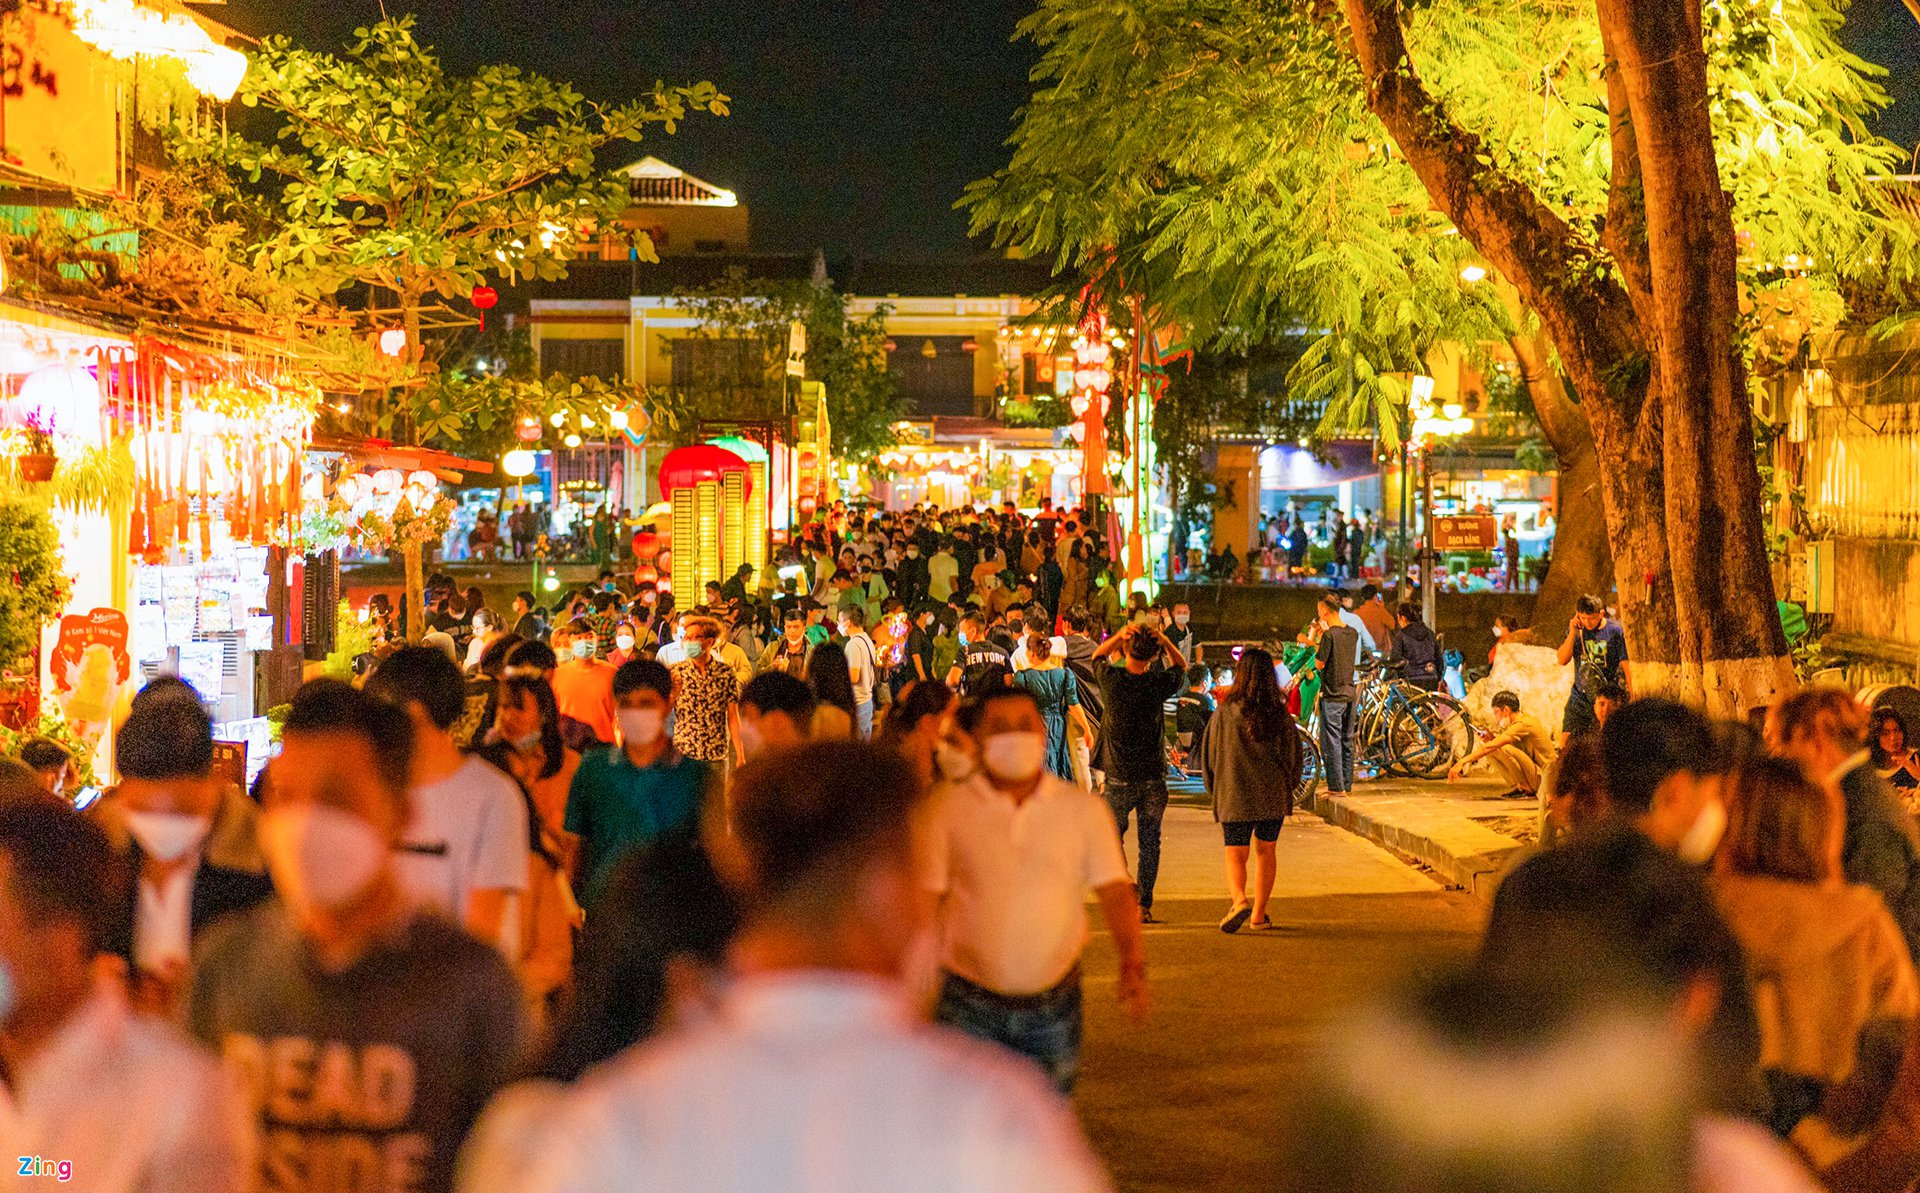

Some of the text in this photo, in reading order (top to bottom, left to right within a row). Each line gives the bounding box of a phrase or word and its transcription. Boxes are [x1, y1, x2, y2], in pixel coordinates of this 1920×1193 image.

[1448, 535, 1463, 546] BẠCH
[72, 628, 84, 636] Kem
[109, 629, 122, 639] Nam
[966, 652, 1005, 666] NEW YORK
